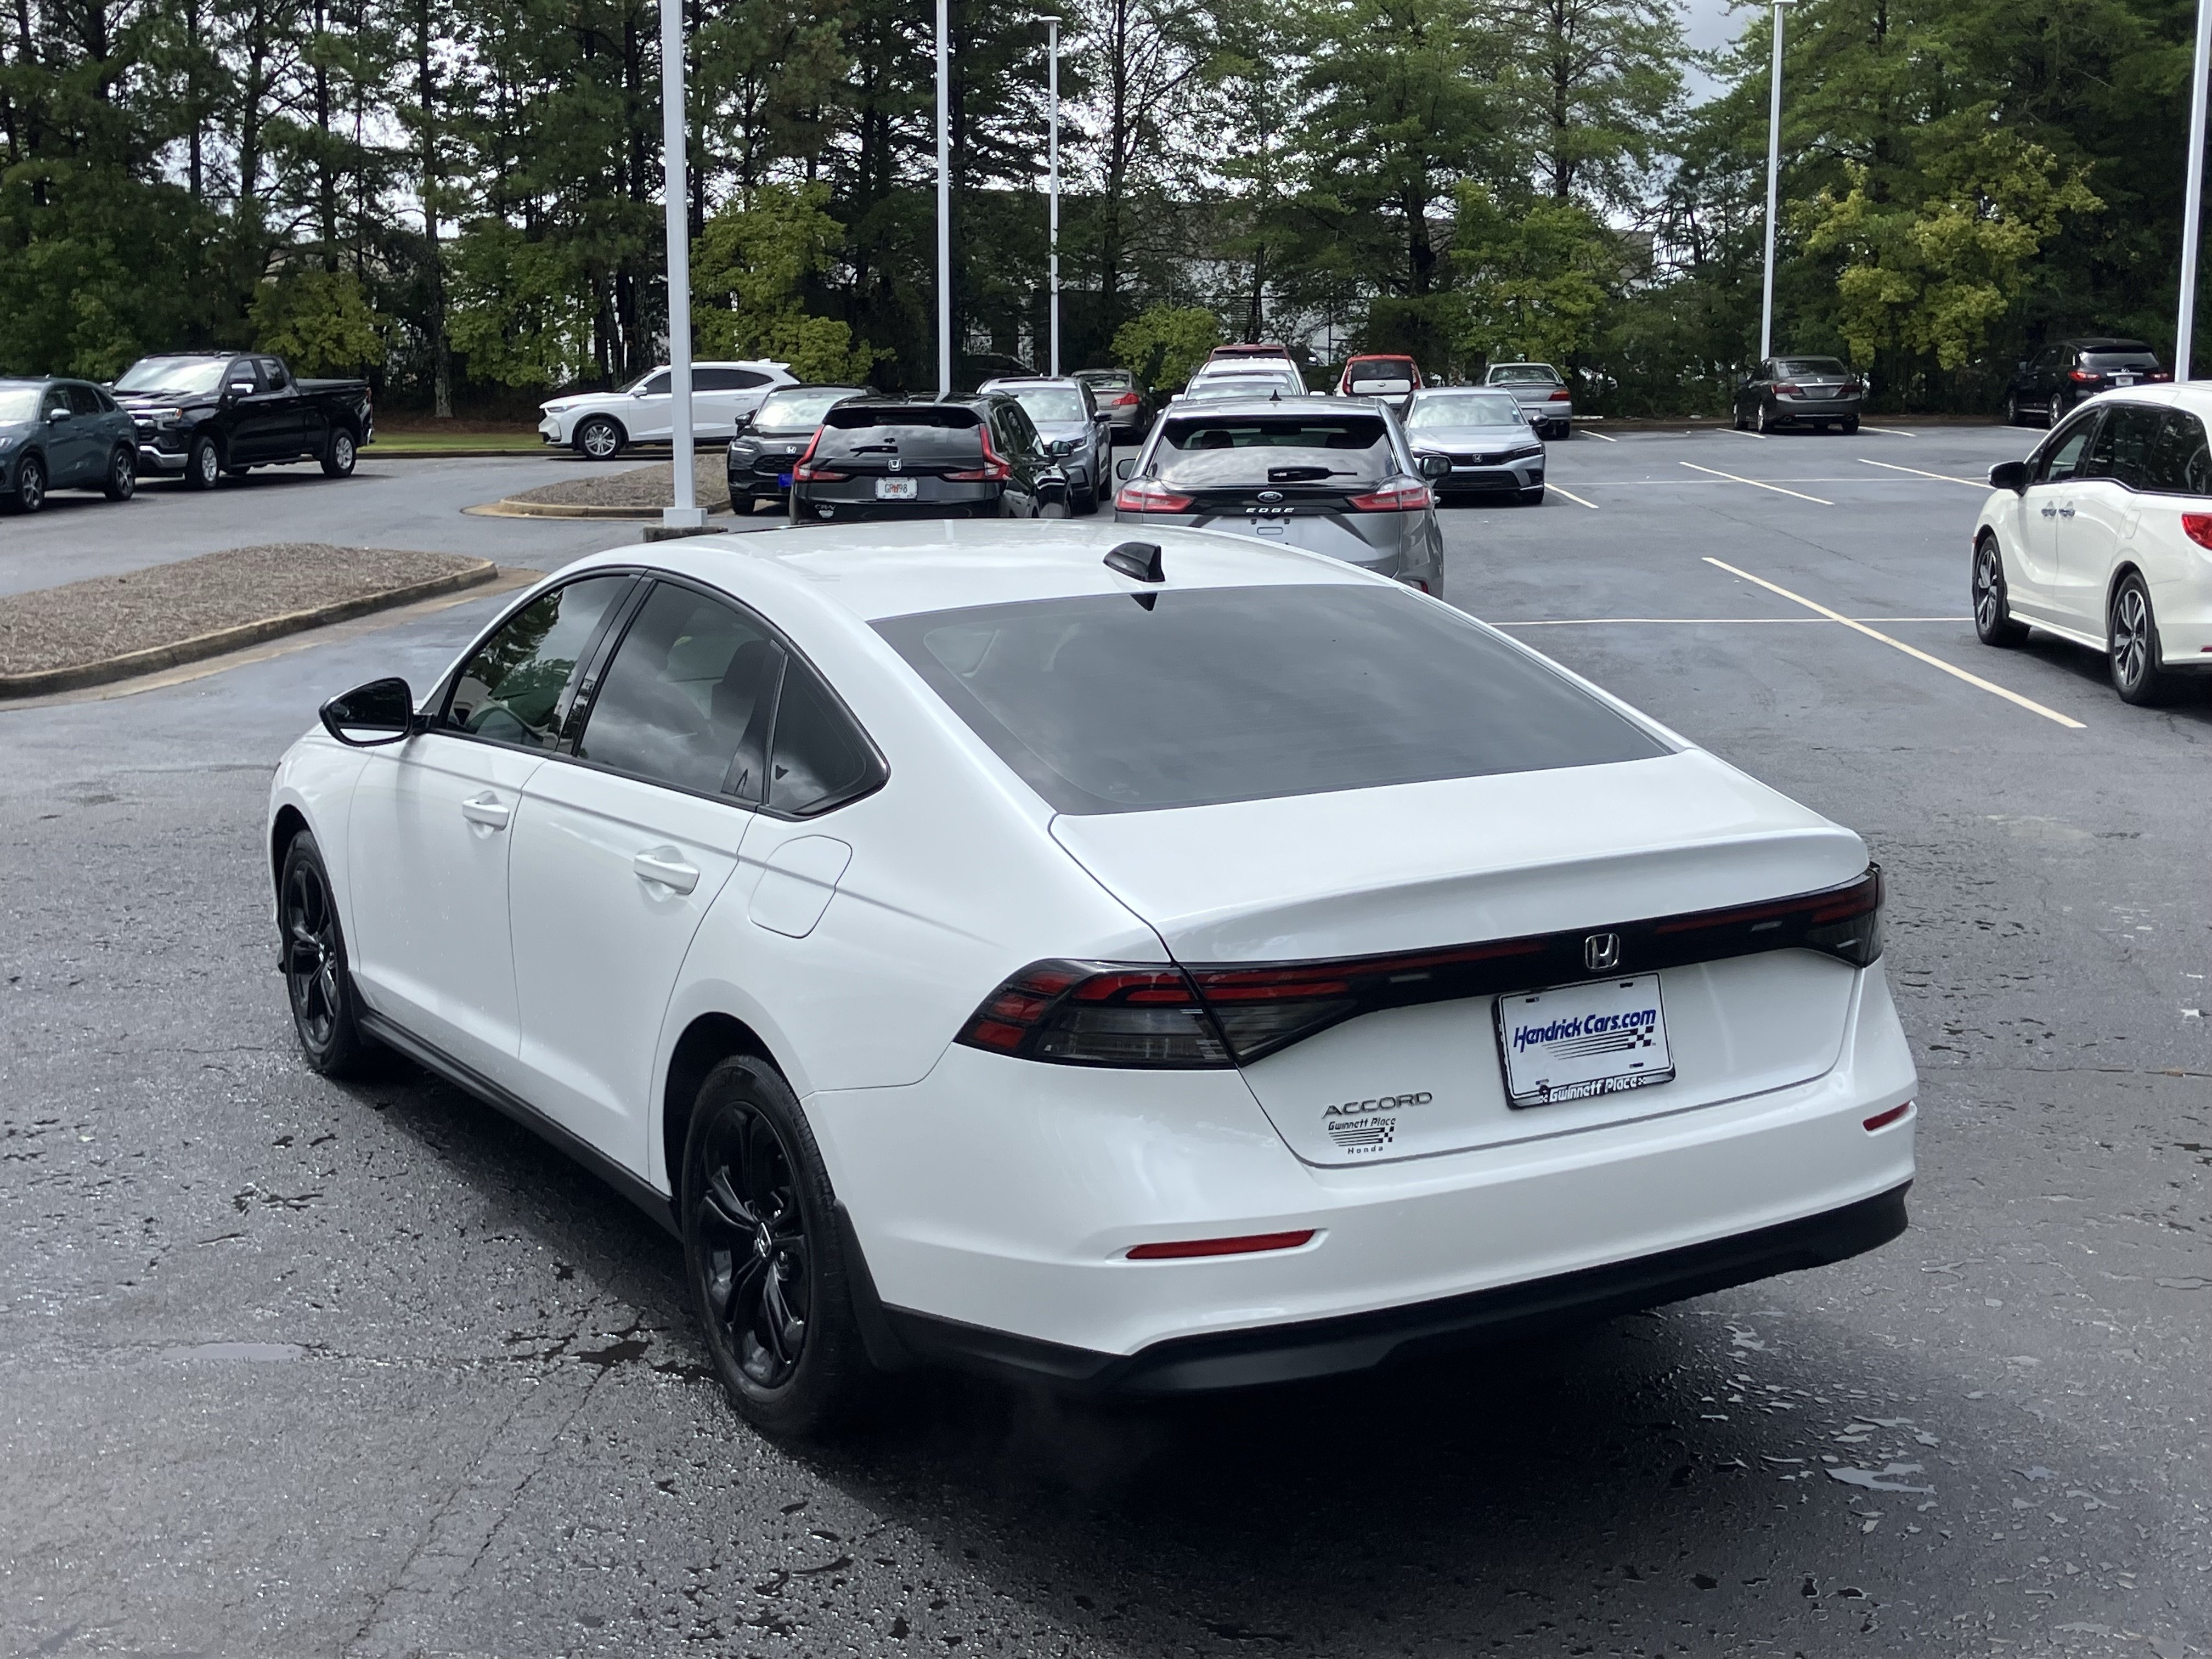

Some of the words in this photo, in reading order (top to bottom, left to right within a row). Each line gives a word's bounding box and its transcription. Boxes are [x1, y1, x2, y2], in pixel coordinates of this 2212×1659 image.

[1549, 1082, 1605, 1102] Gwinnett
[1605, 1076, 1637, 1093] Place
[1321, 1092, 1432, 1119] ACCORD
[1328, 1118, 1368, 1131] Gwinnett
[1370, 1117, 1396, 1126] Place
[1347, 1146, 1383, 1154] Honda
